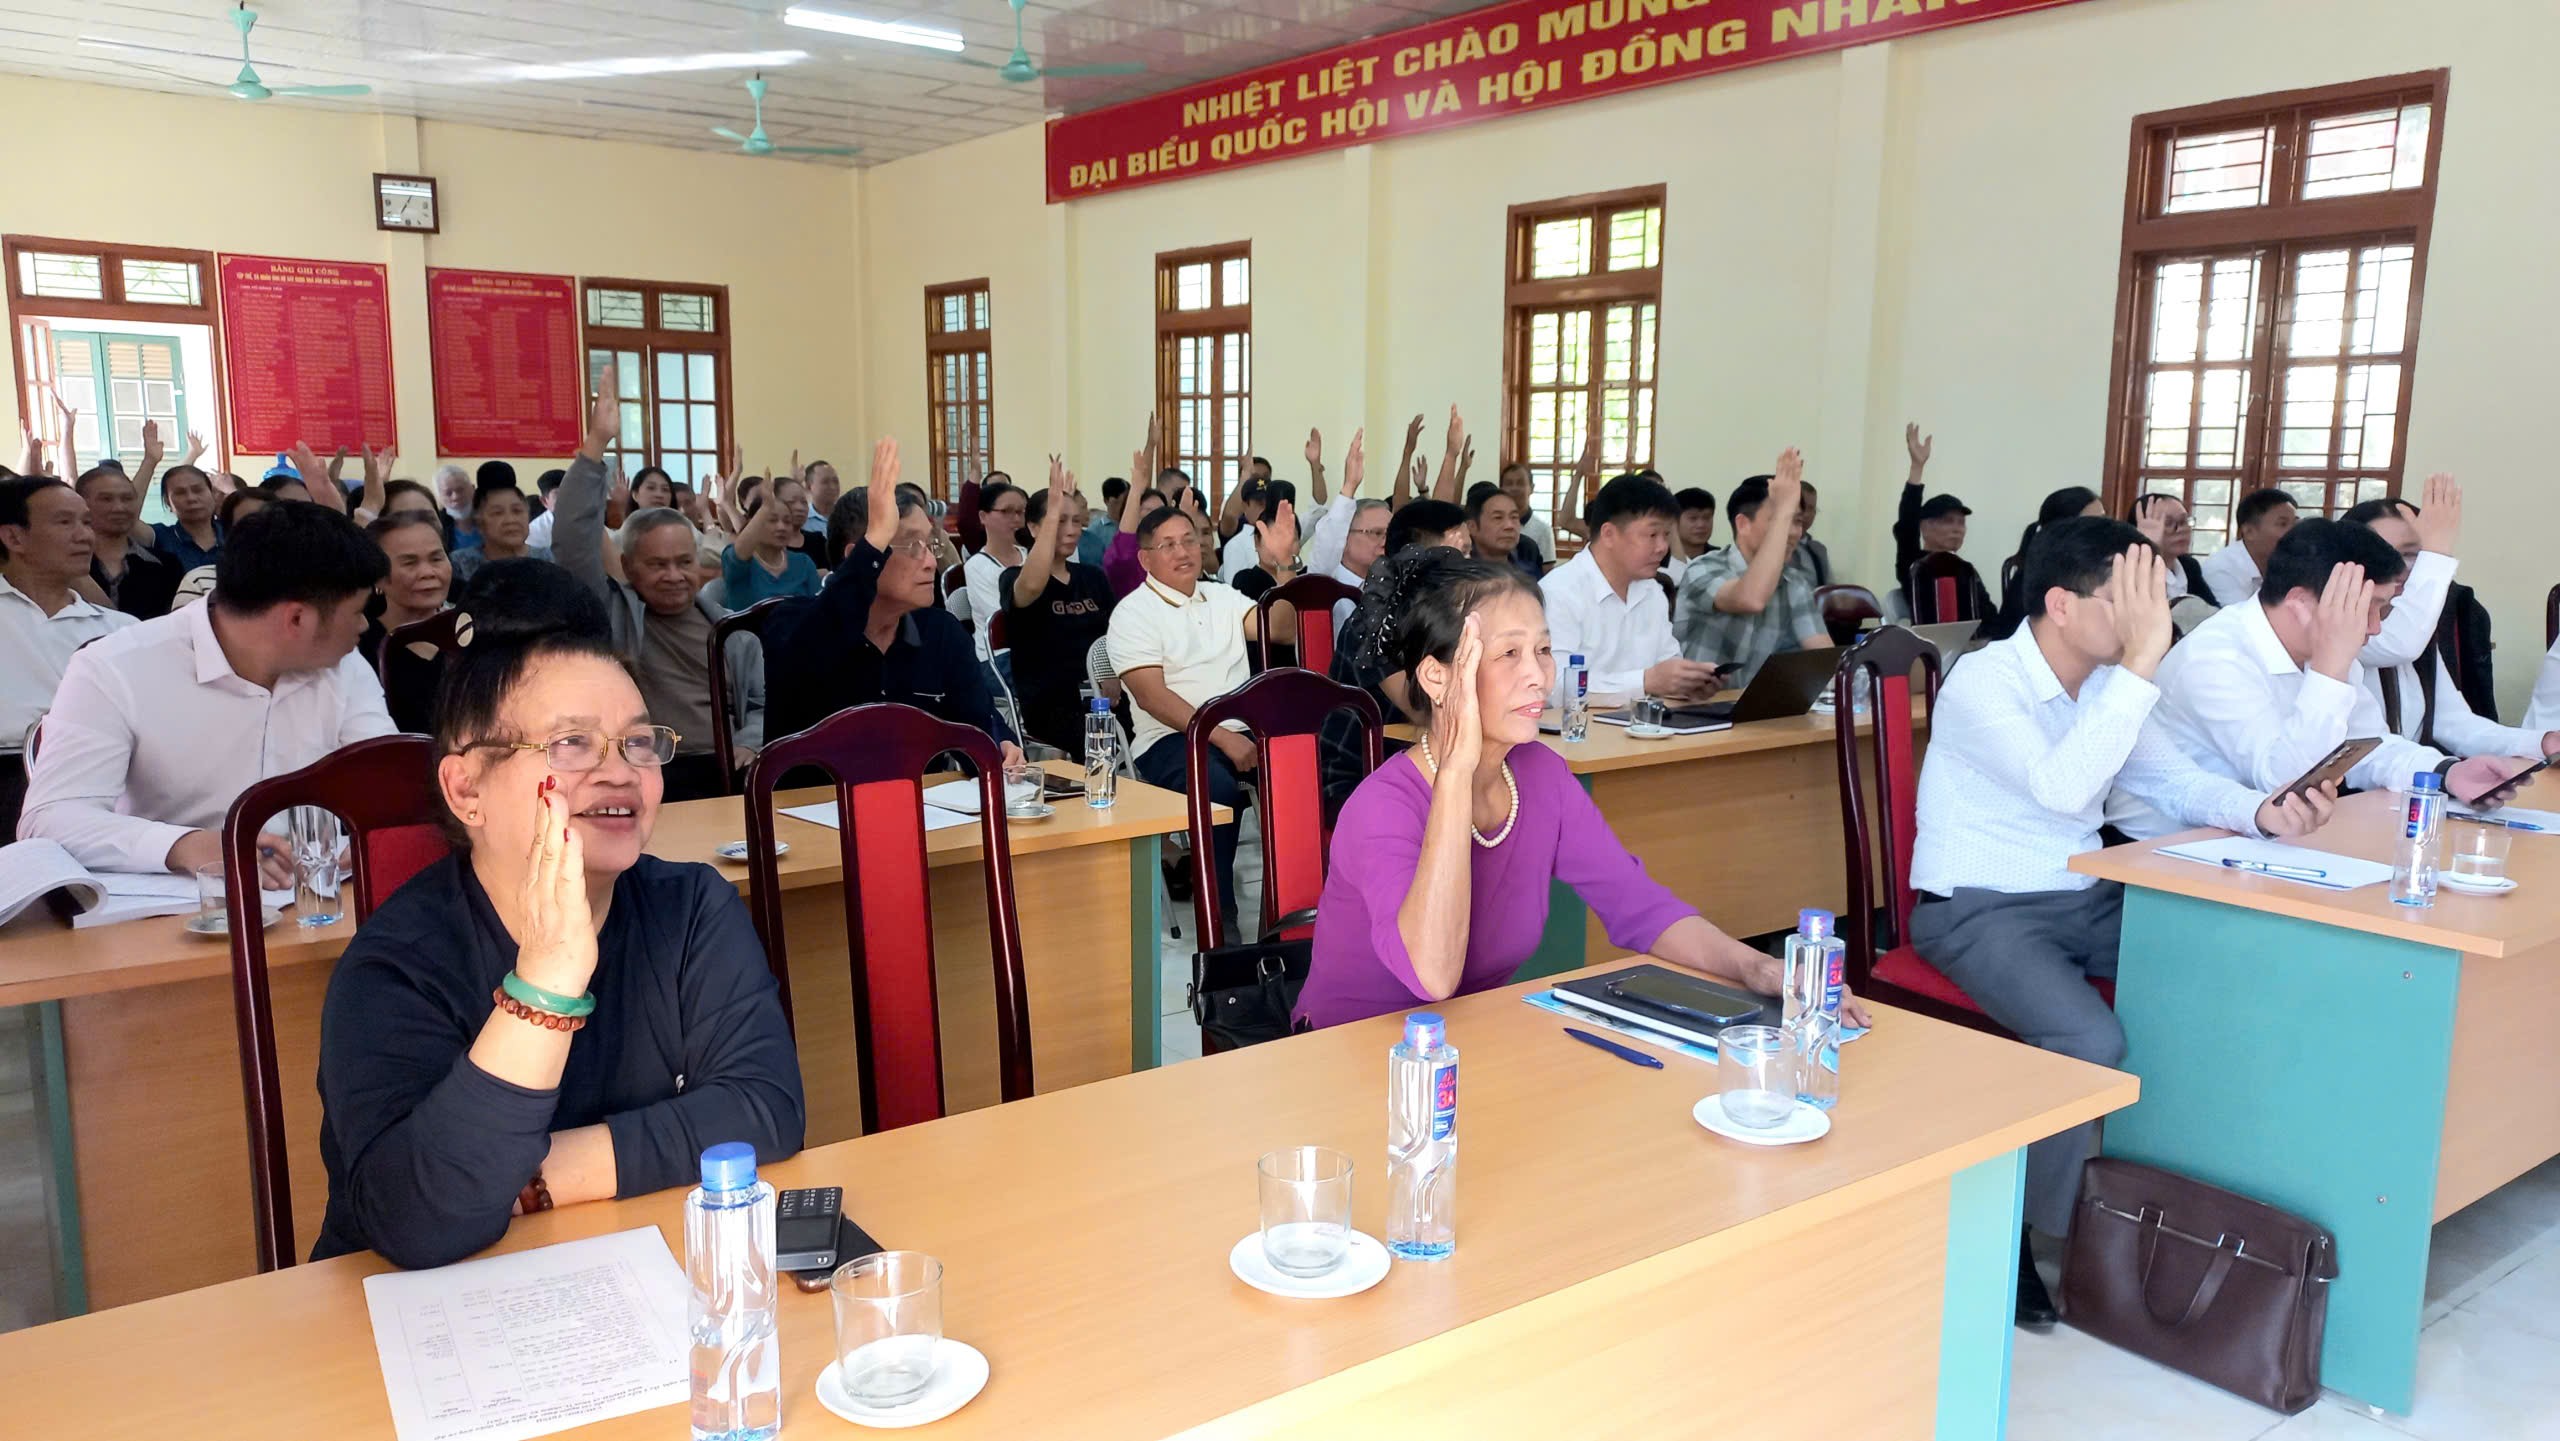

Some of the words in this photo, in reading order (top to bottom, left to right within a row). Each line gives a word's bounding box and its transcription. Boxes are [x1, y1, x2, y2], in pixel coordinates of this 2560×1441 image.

[1069, 157, 1117, 188] ĐẠI
[1128, 135, 1199, 178] BIỂU
[1211, 112, 1307, 162] QUỐC
[1321, 99, 1389, 138] HỘI
[1404, 80, 1461, 120] VÀ
[1478, 60, 1562, 105] HỘI
[1580, 26, 1746, 84] ĐỒNG
[1183, 80, 1285, 128] NHIỆT
[1298, 57, 1379, 101] LIỆT
[1393, 23, 1519, 78] CHÀO
